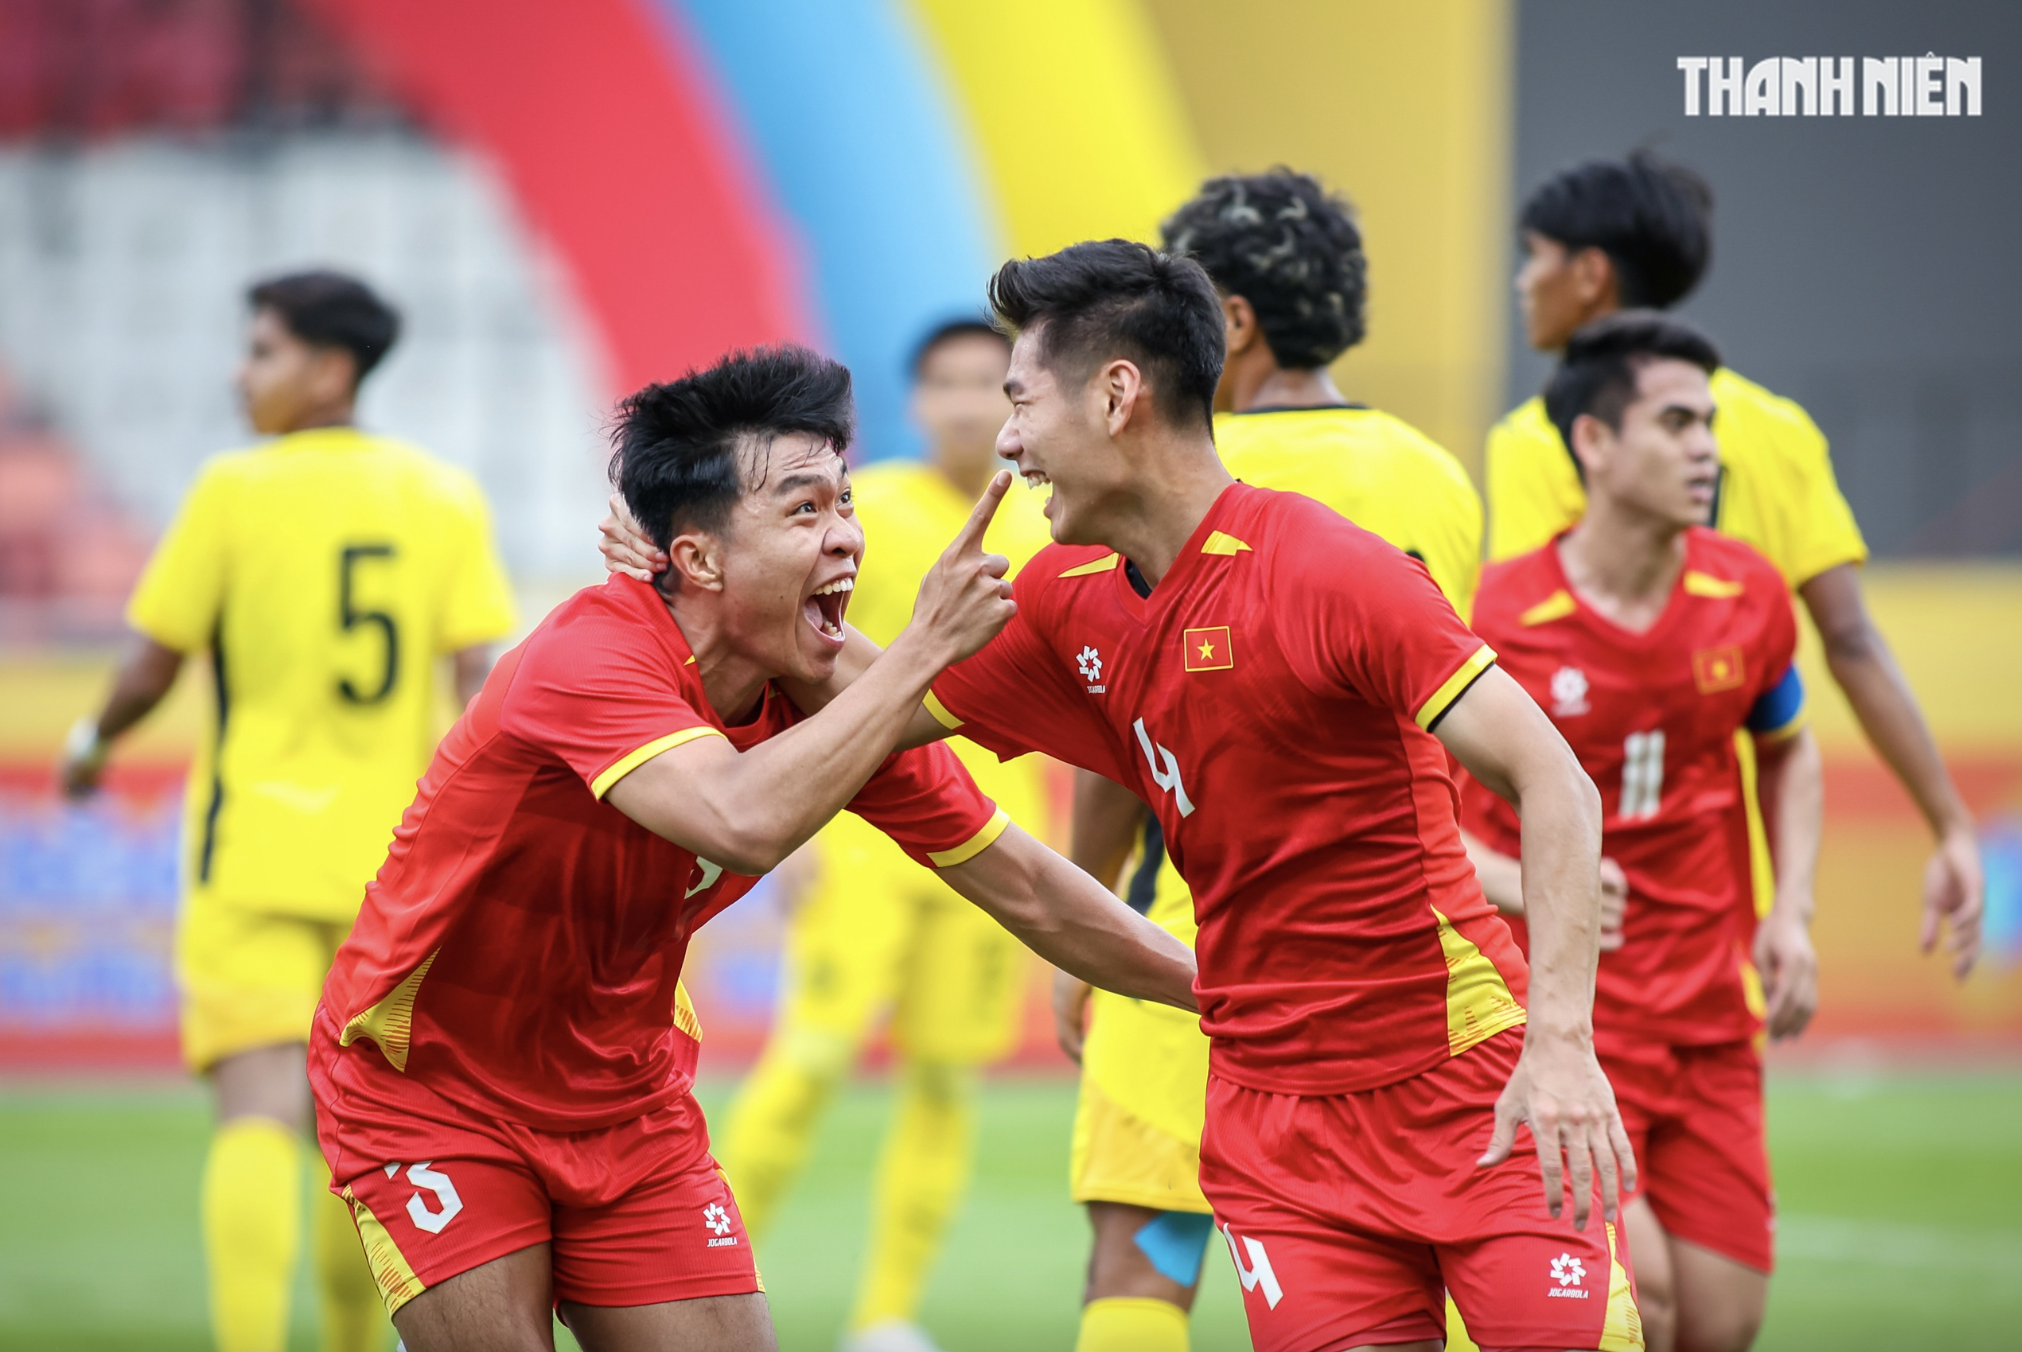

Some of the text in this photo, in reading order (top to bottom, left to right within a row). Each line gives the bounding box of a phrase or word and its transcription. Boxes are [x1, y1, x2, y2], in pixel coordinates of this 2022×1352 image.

[338, 544, 401, 706] 5
[1132, 716, 1196, 819] 4
[1618, 729, 1666, 822] 11
[1222, 1222, 1284, 1312] 4
[1547, 1287, 1589, 1299] JOGARBOLA
